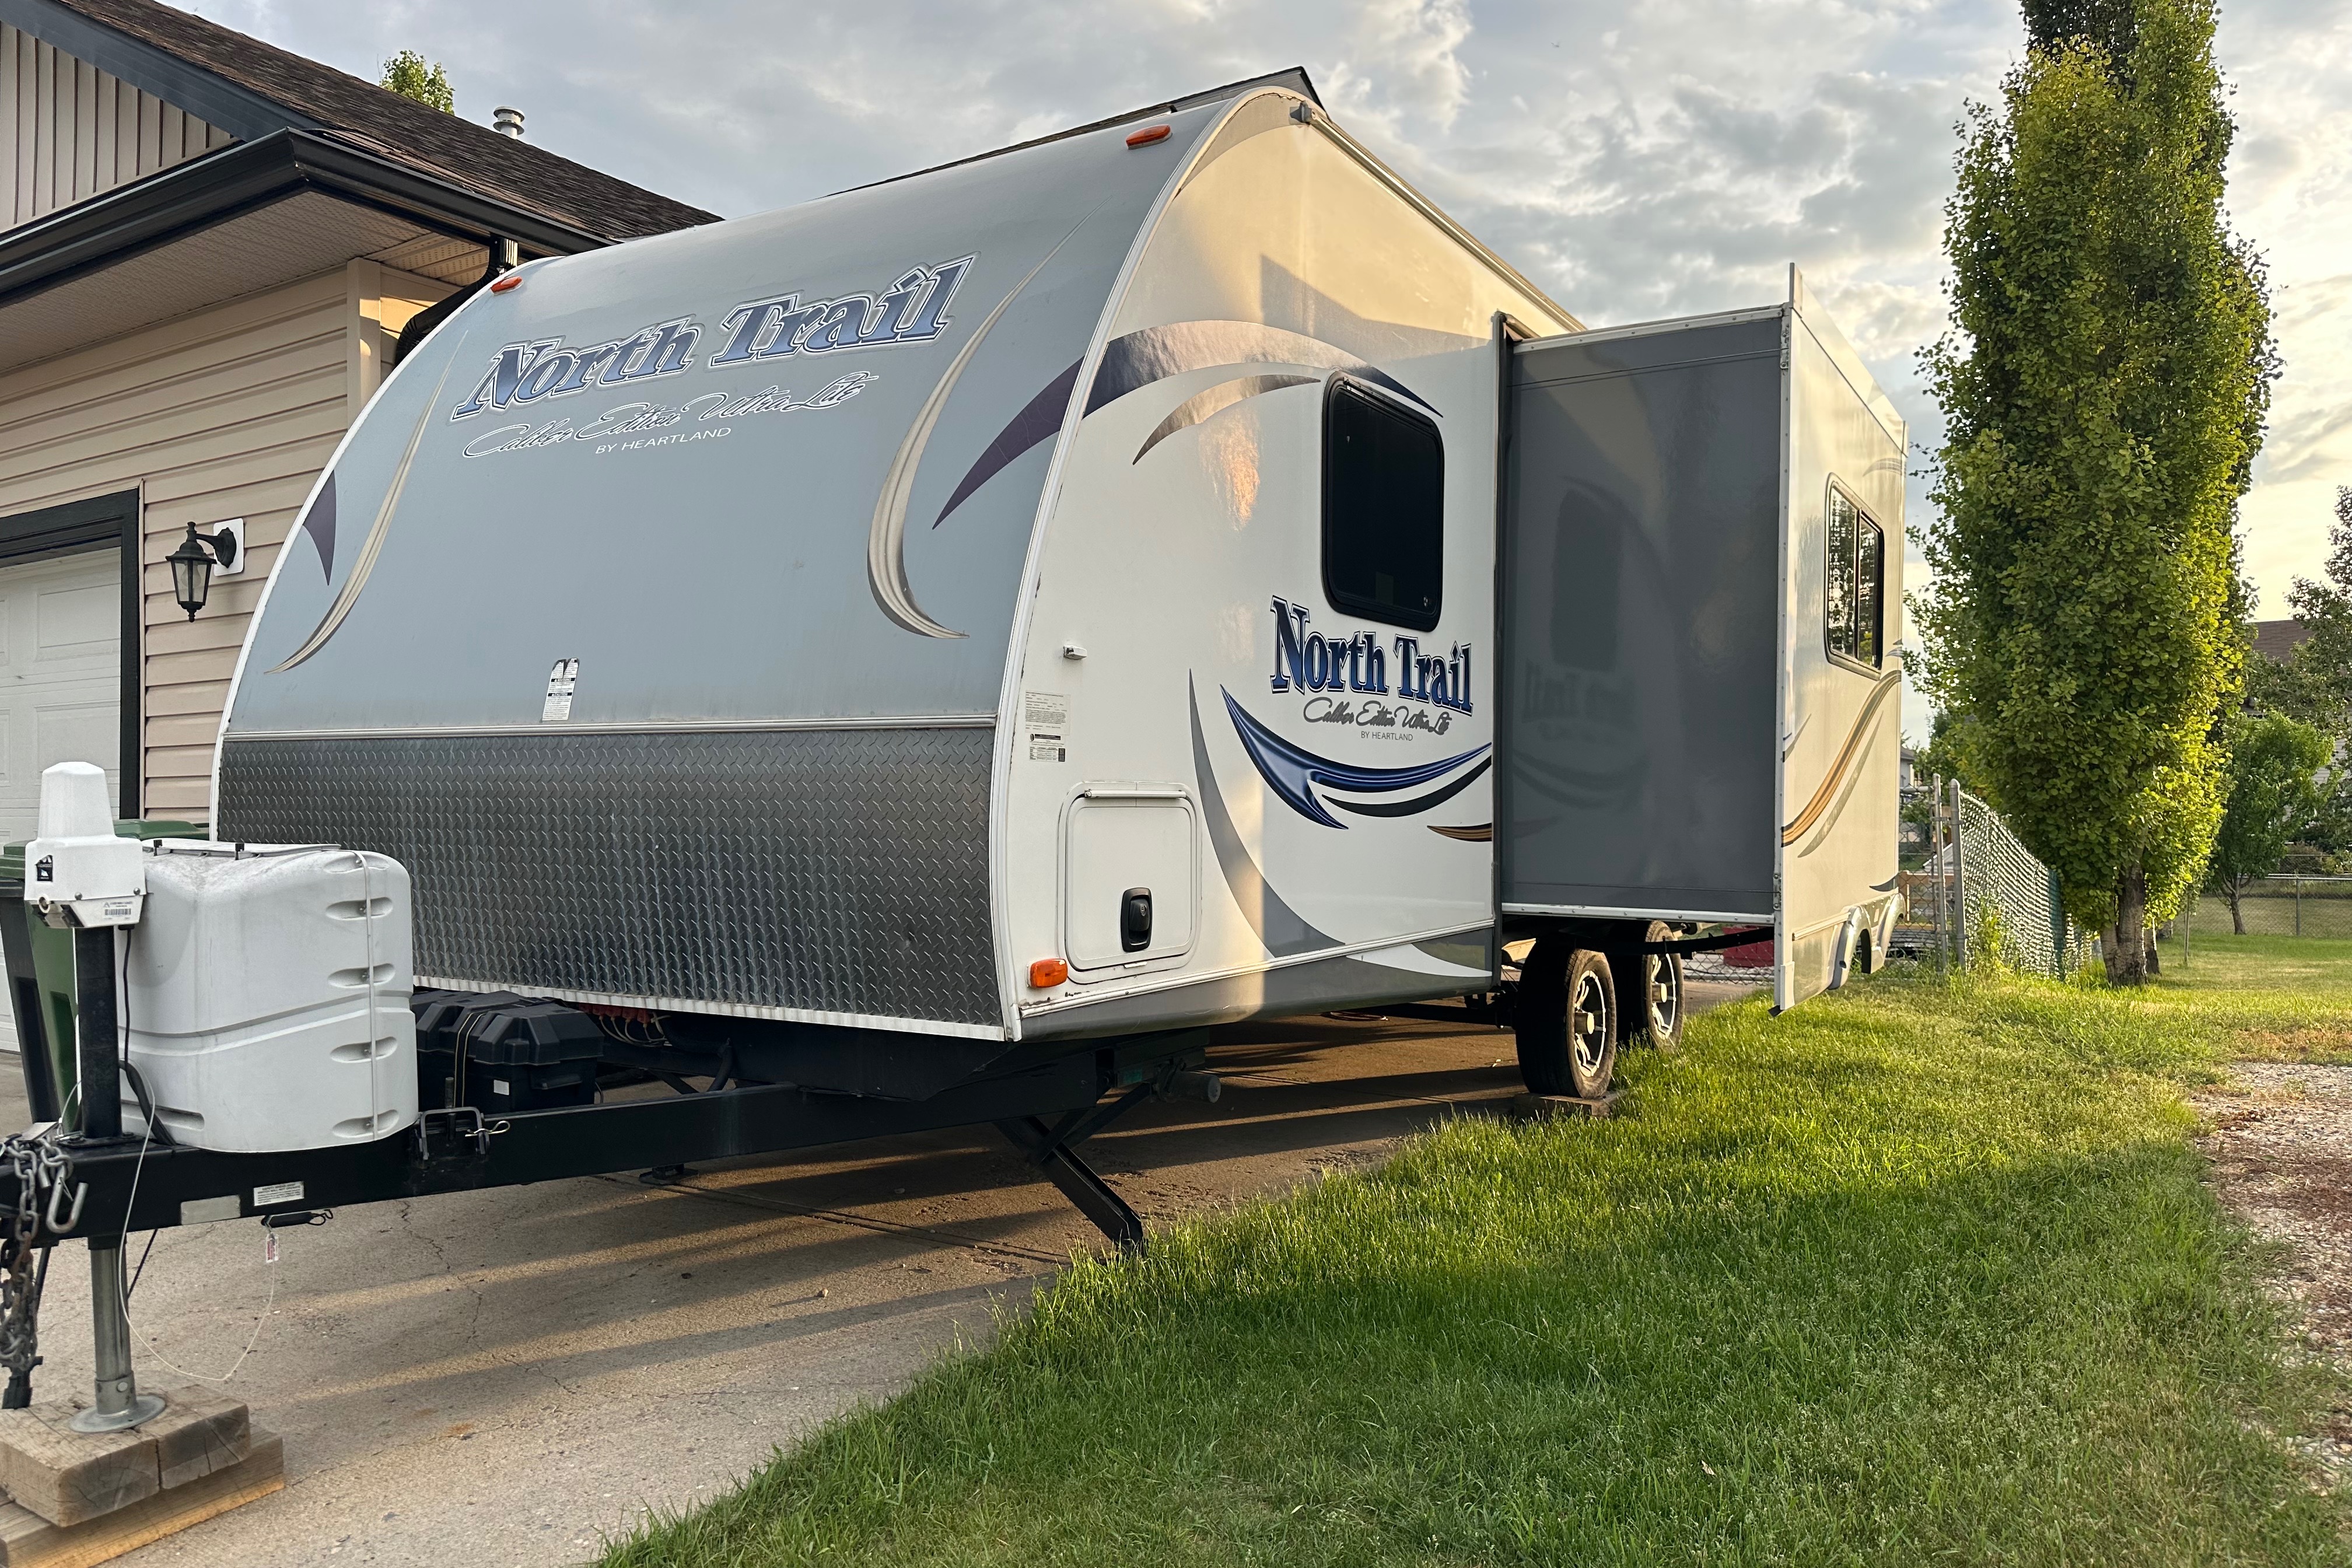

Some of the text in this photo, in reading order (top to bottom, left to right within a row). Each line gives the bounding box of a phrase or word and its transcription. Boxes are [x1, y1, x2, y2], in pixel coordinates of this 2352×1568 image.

[451, 255, 976, 421] North Trail
[574, 402, 681, 442] Edition
[595, 428, 732, 454] BY HEARTLAND
[1270, 595, 1474, 716] North Trail
[1360, 730, 1413, 741] BY HEARTLAND
